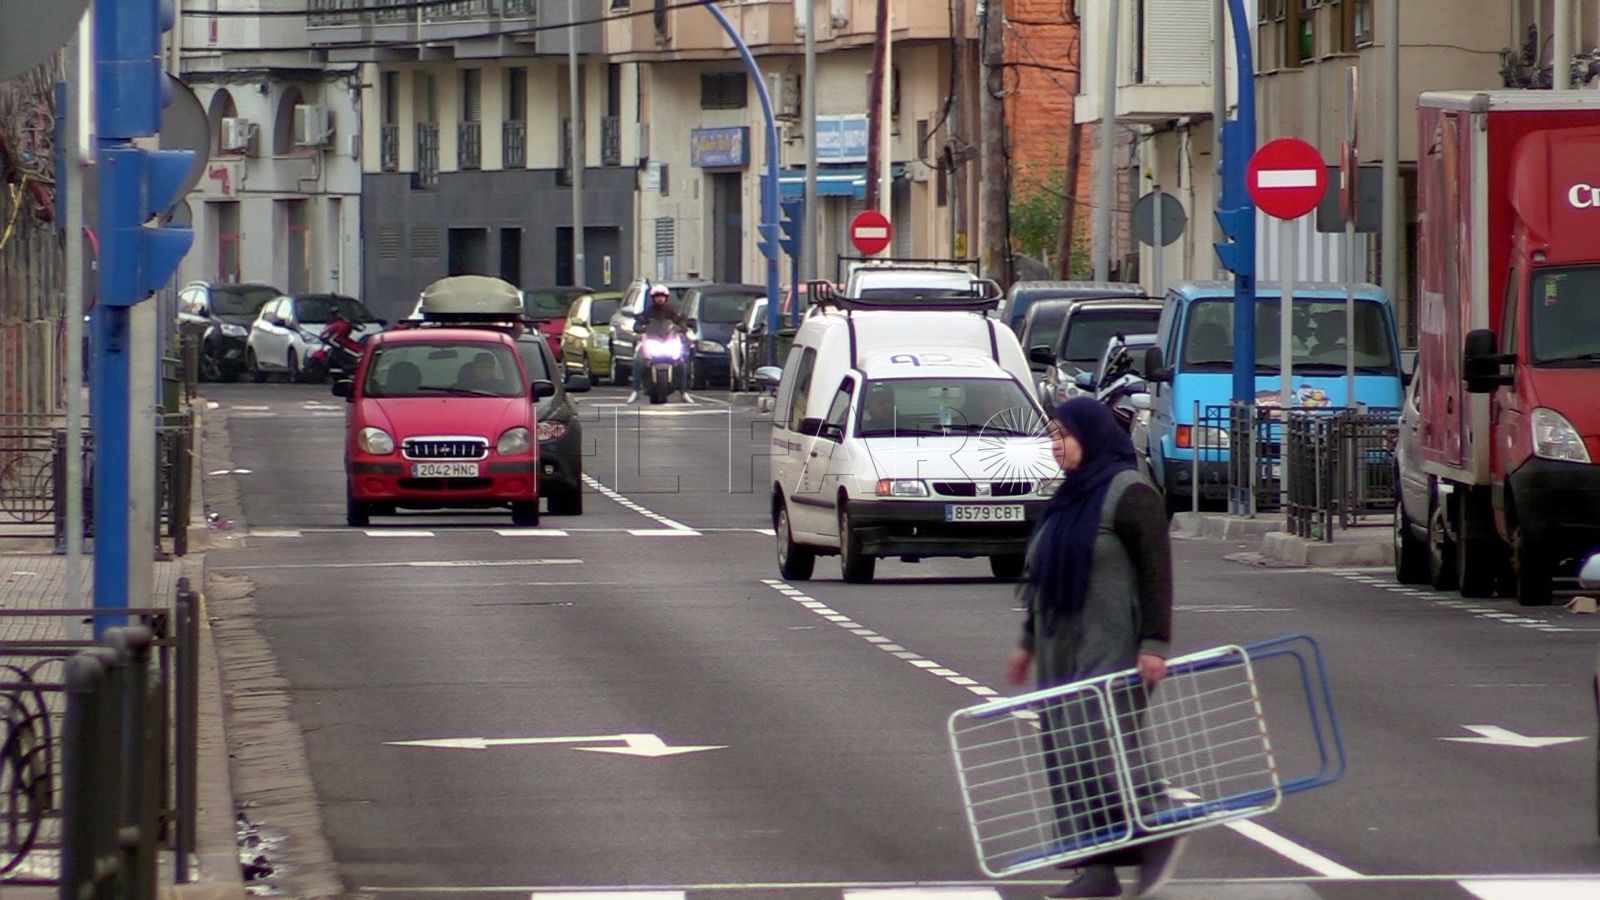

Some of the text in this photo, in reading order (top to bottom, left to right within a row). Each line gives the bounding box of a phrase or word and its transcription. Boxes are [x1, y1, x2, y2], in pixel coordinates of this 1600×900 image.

[420, 464, 476, 476] 2042 HNC
[954, 506, 1021, 520] 8579 CBT
